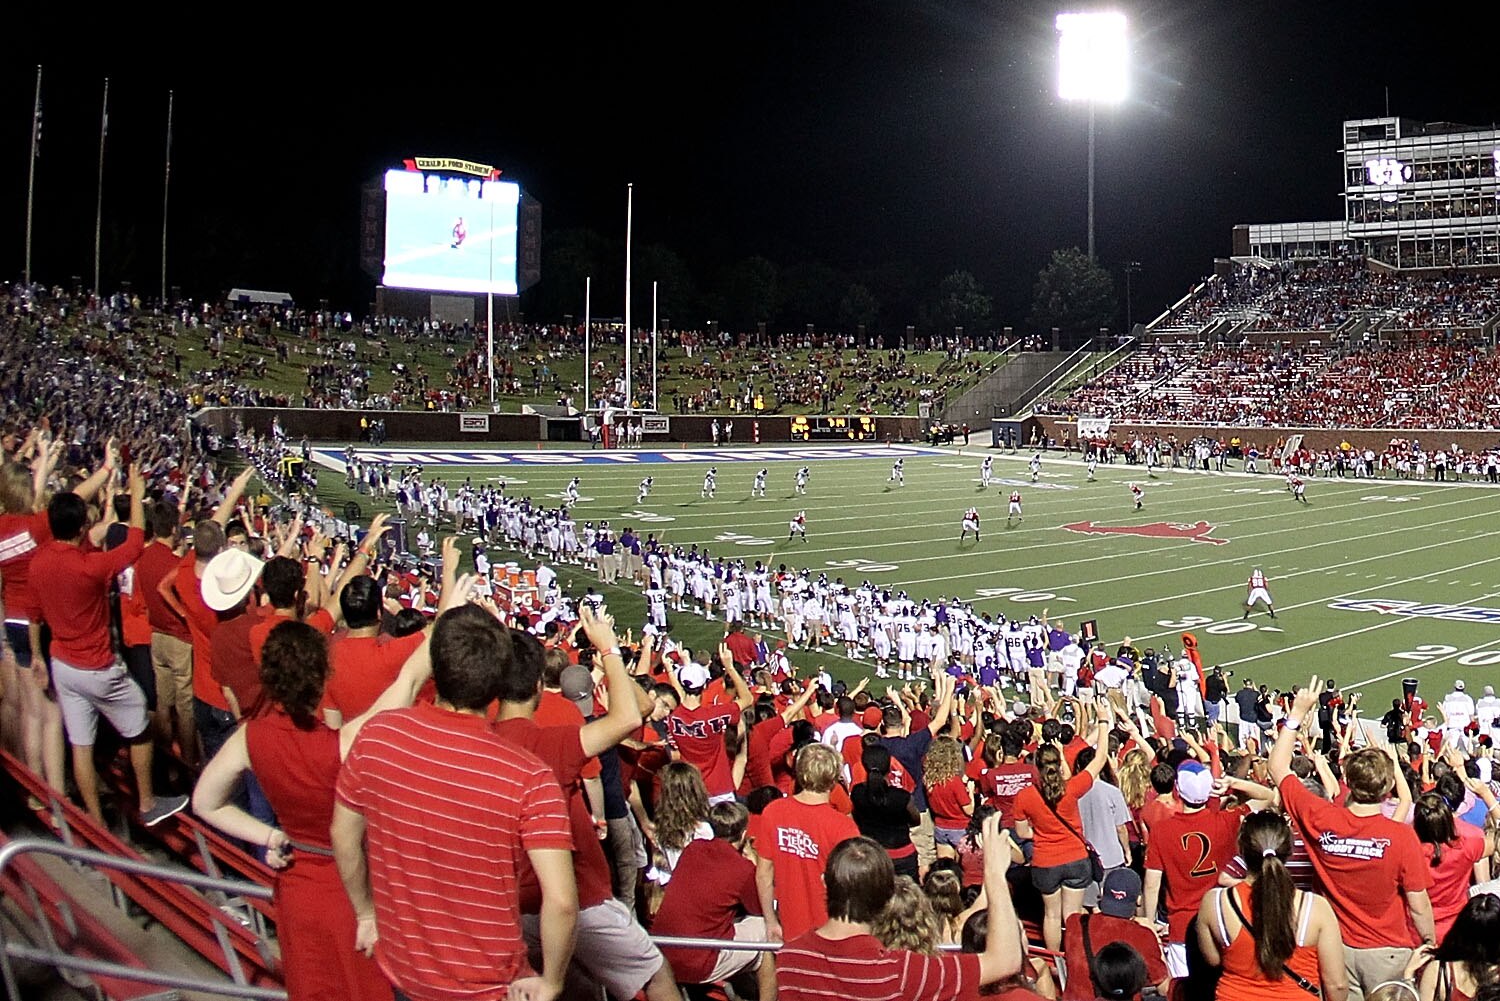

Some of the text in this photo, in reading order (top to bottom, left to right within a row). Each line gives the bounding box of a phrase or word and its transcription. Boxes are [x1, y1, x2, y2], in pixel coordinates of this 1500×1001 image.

[418, 159, 441, 167] GERALD
[448, 160, 464, 169] FORD
[464, 163, 490, 175] STADIUM
[652, 594, 663, 603] 13
[975, 587, 1057, 602] 40
[1156, 616, 1258, 635] 30
[1181, 830, 1218, 878] 2
[1355, 844, 1384, 858] BACK
